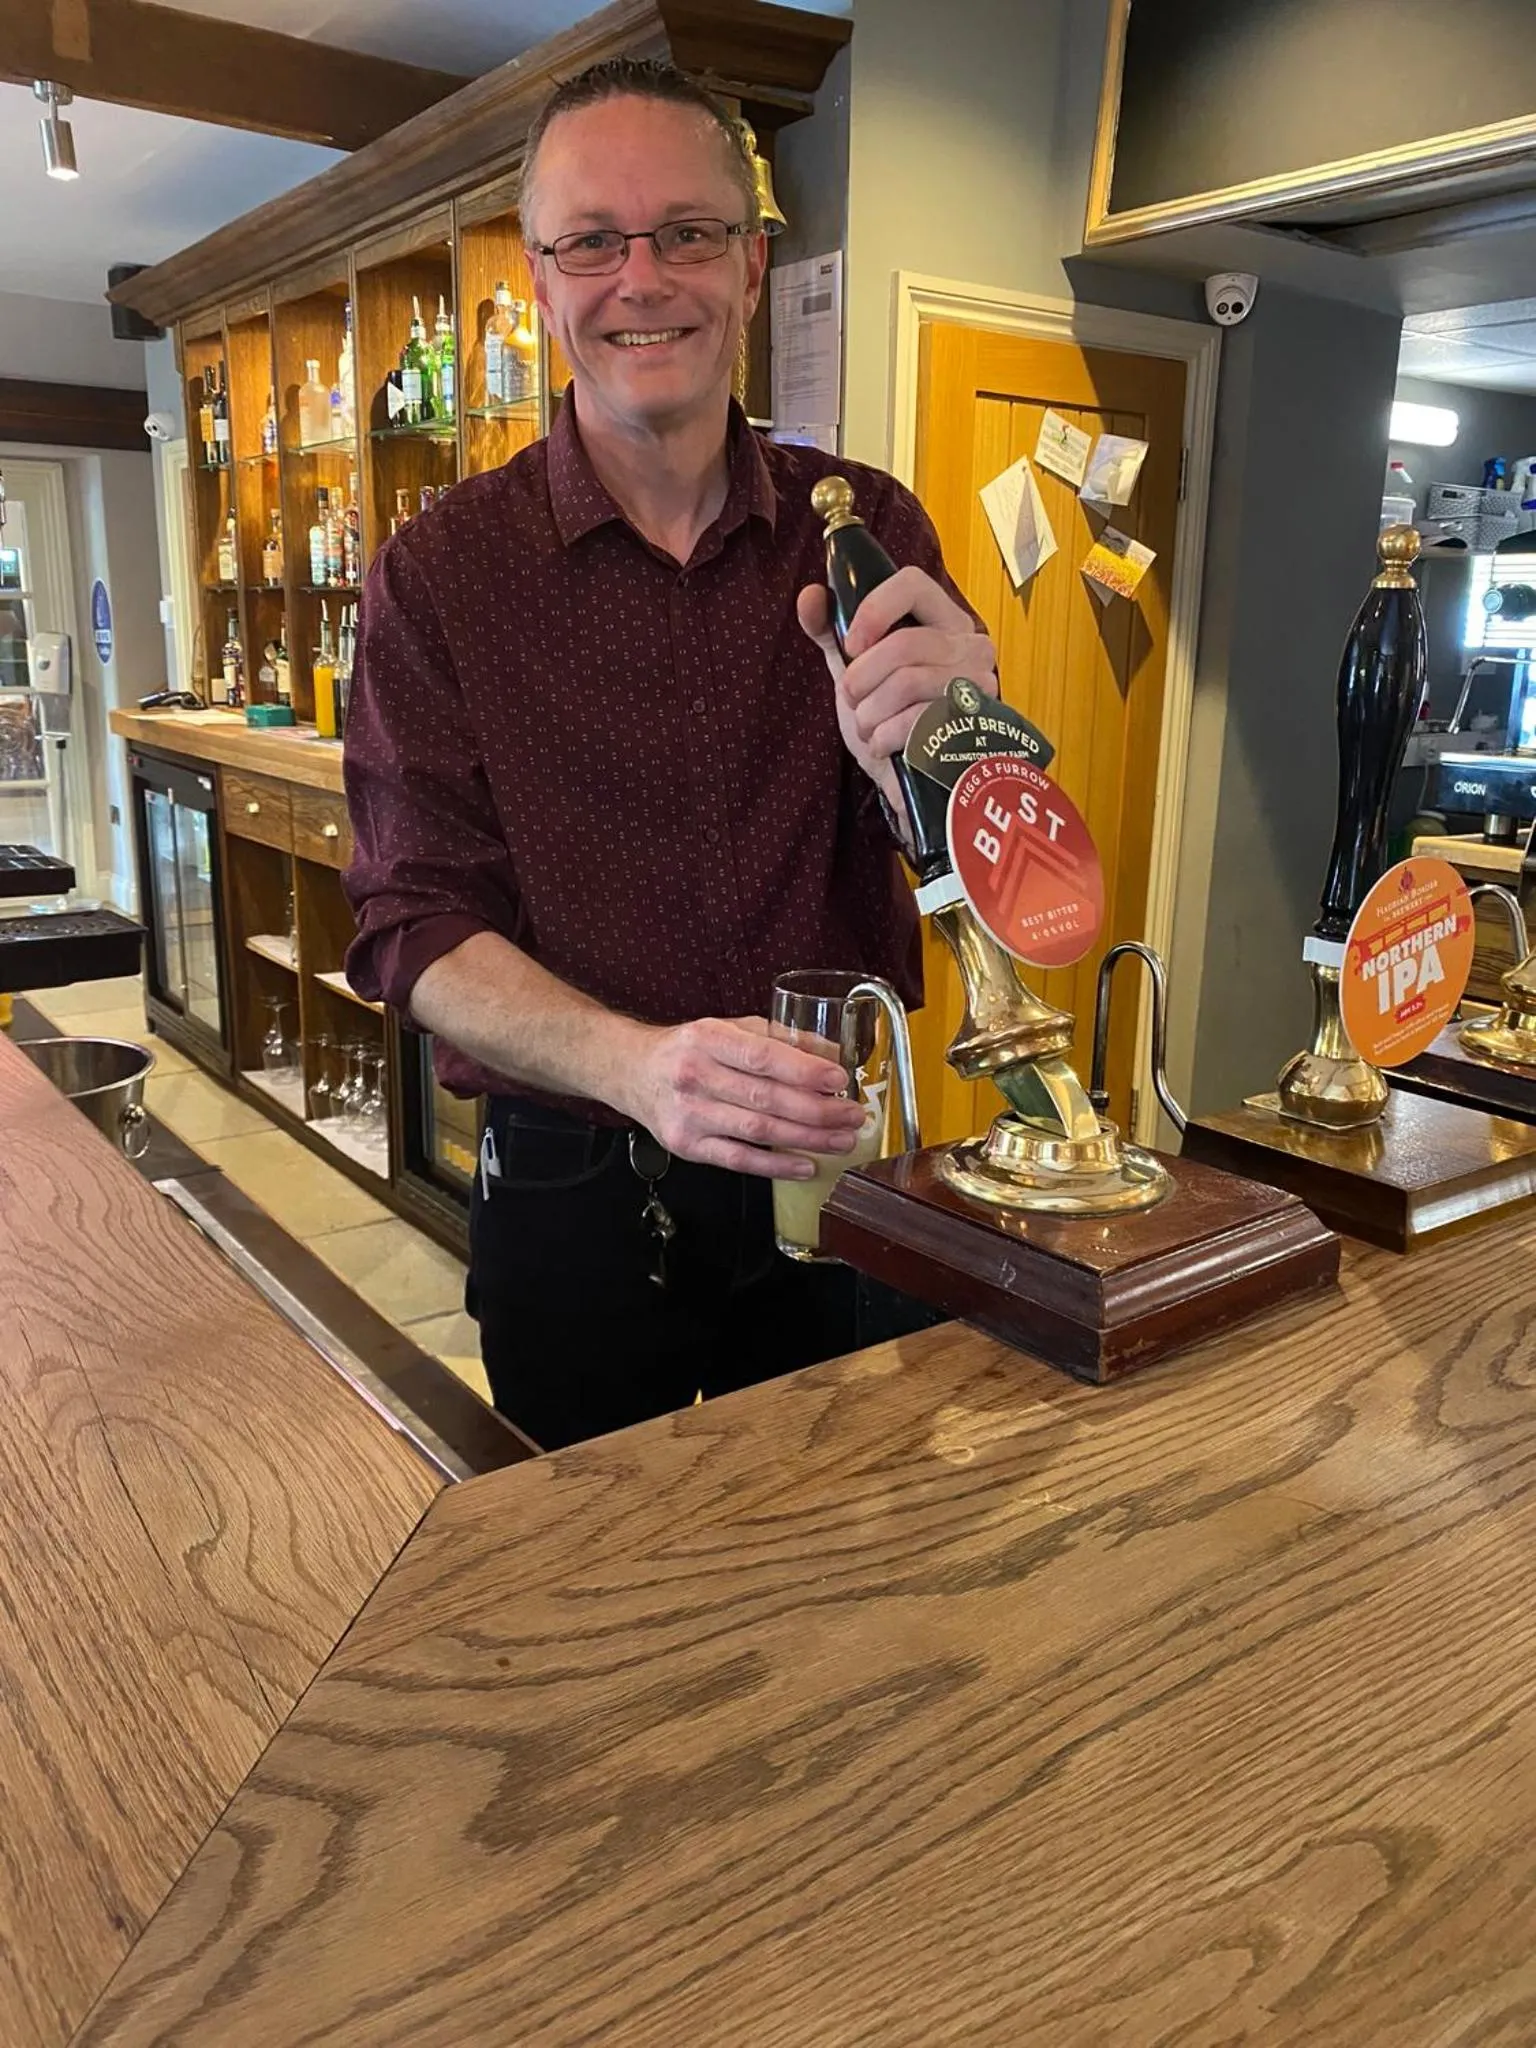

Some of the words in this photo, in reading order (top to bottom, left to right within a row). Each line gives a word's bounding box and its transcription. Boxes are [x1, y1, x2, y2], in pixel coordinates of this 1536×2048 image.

[922, 716, 975, 758] LOCALLY
[978, 716, 1040, 754] BREWED
[975, 736, 988, 747] AT
[958, 772, 982, 808] RIGG
[994, 762, 1050, 791] FURROW
[1453, 779, 1488, 797] ORION
[972, 791, 1067, 865] BEST
[1021, 913, 1045, 928] BEST
[1046, 904, 1080, 921] BITTER
[1361, 912, 1457, 982] NORTHERN
[1377, 943, 1446, 1016] IPA
